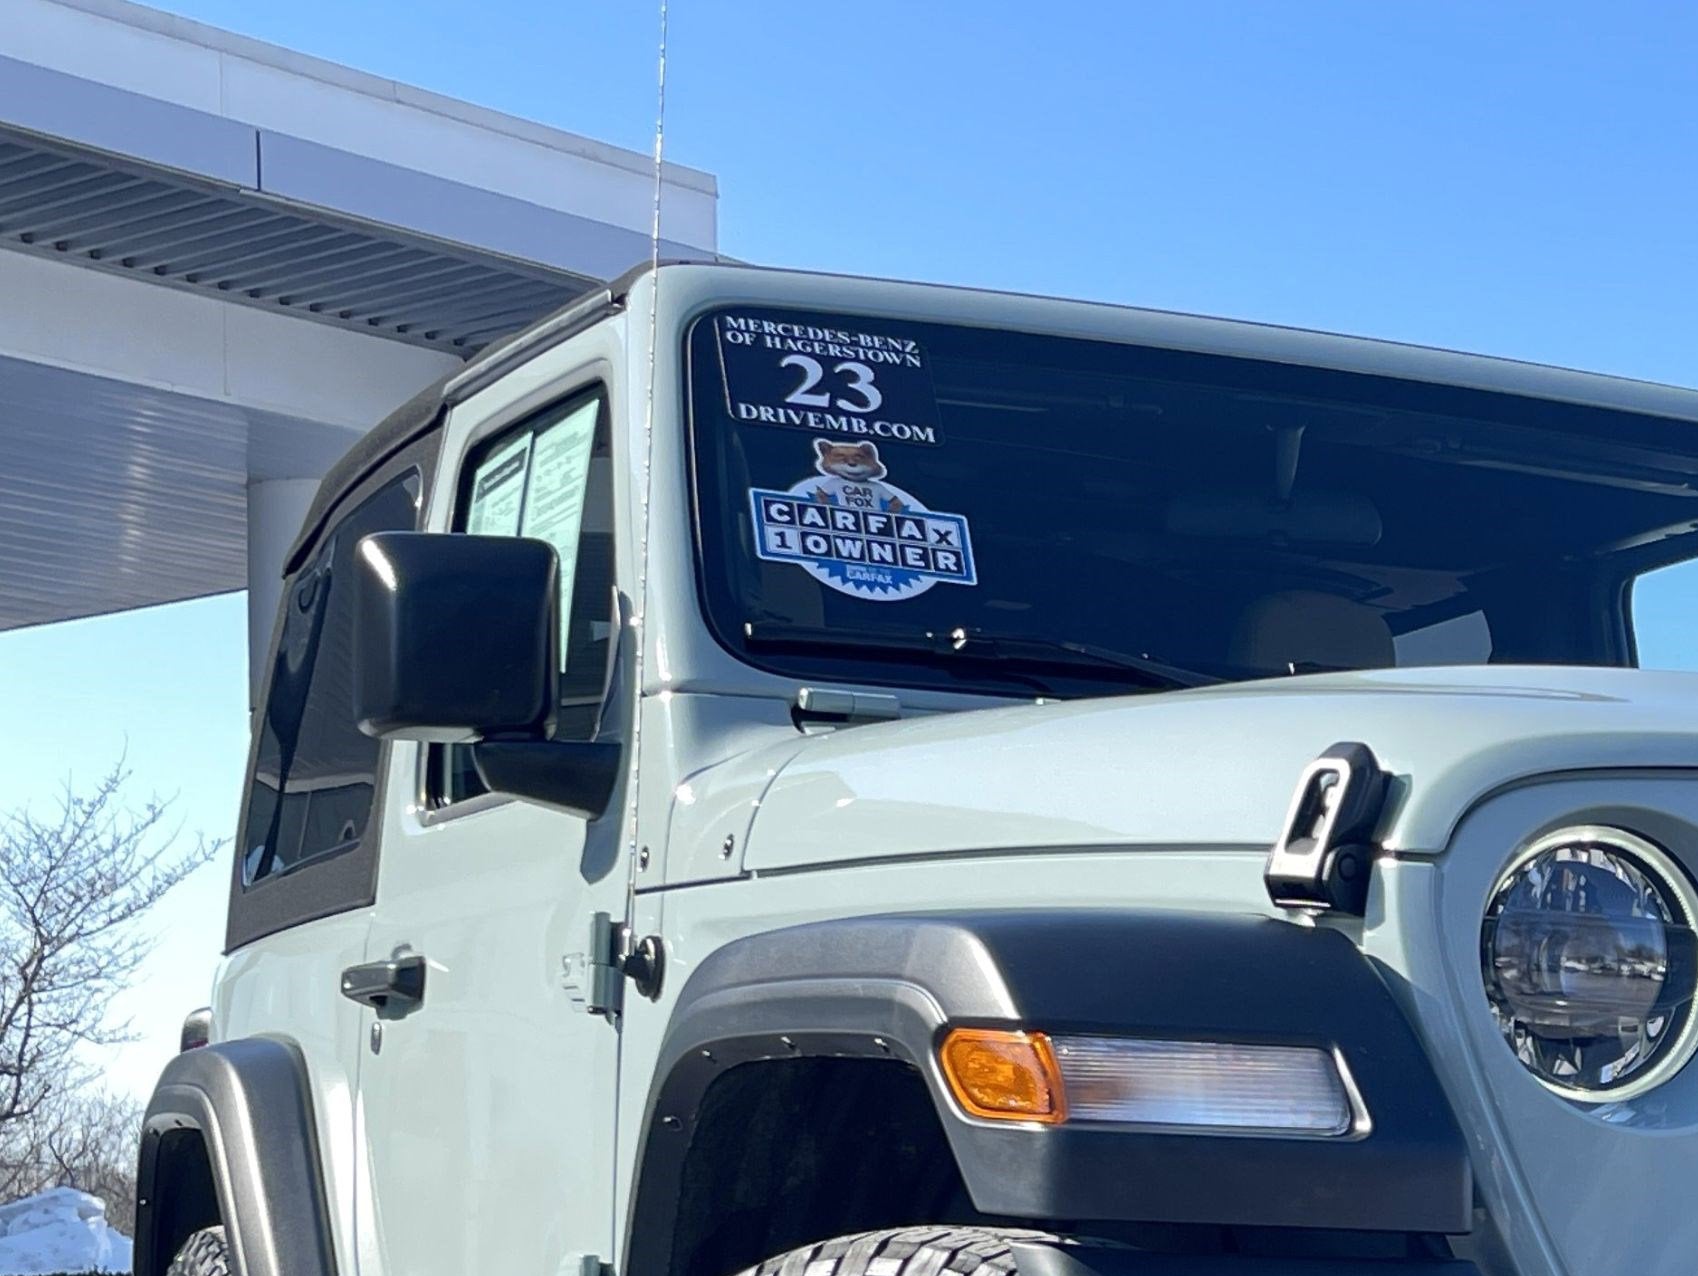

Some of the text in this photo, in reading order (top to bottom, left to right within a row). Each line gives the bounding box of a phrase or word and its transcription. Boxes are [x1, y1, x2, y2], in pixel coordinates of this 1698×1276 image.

[725, 315, 920, 354] MERCEDES-BENZ
[726, 331, 922, 368] OF HAGERSTOWN
[780, 354, 883, 413] 23
[739, 403, 936, 443] DRIVEMB.COM
[842, 485, 873, 498] CAR
[845, 495, 874, 508] FOX
[768, 503, 954, 547] CARFAX
[774, 530, 959, 571] 1 OWNER
[847, 570, 893, 584] CARFAX
